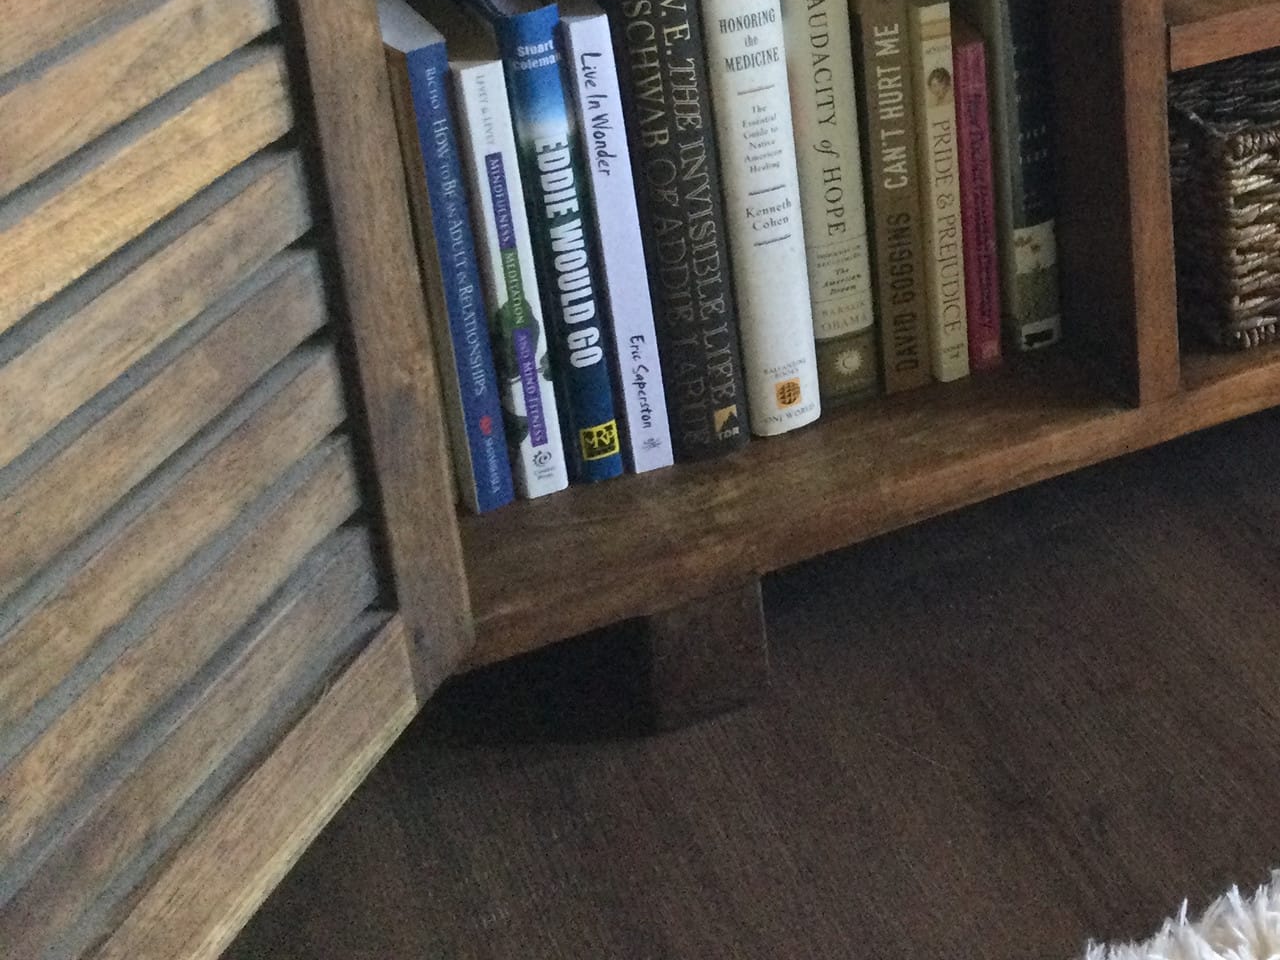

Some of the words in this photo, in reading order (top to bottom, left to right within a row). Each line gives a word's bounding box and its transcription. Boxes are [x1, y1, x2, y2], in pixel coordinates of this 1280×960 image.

[516, 40, 554, 58] Stuart
[719, 8, 776, 34] HONORING
[744, 34, 758, 47] the
[873, 23, 901, 58] ME
[580, 52, 602, 88] Live
[725, 46, 780, 73] MEDICINE
[586, 94, 608, 110] In
[668, 57, 703, 131] THE
[876, 64, 905, 121] HURT
[592, 113, 617, 176] Wonder
[813, 138, 840, 159] of
[880, 128, 909, 190] CAN'T
[932, 120, 953, 187] PRIDE
[534, 139, 580, 219] EDDIE
[649, 158, 680, 208] OF
[745, 198, 792, 218] Kenneth
[823, 166, 846, 236] HOPE
[935, 193, 955, 211] &
[679, 136, 726, 321] INVISIBLE
[752, 215, 789, 231] Cohen
[433, 118, 450, 161] HOW
[448, 220, 467, 271] ADULT
[459, 285, 487, 396] RELATIONSHIPS
[549, 218, 596, 325] WOULD
[654, 218, 694, 327] ADDIE
[886, 212, 914, 305] GOGGINS
[936, 214, 962, 336] PREJUDICE
[567, 326, 603, 369] GO
[629, 334, 645, 360] Eric
[703, 321, 737, 404] LIFE
[893, 311, 920, 372] DAVID
[632, 365, 653, 428] Saperston
